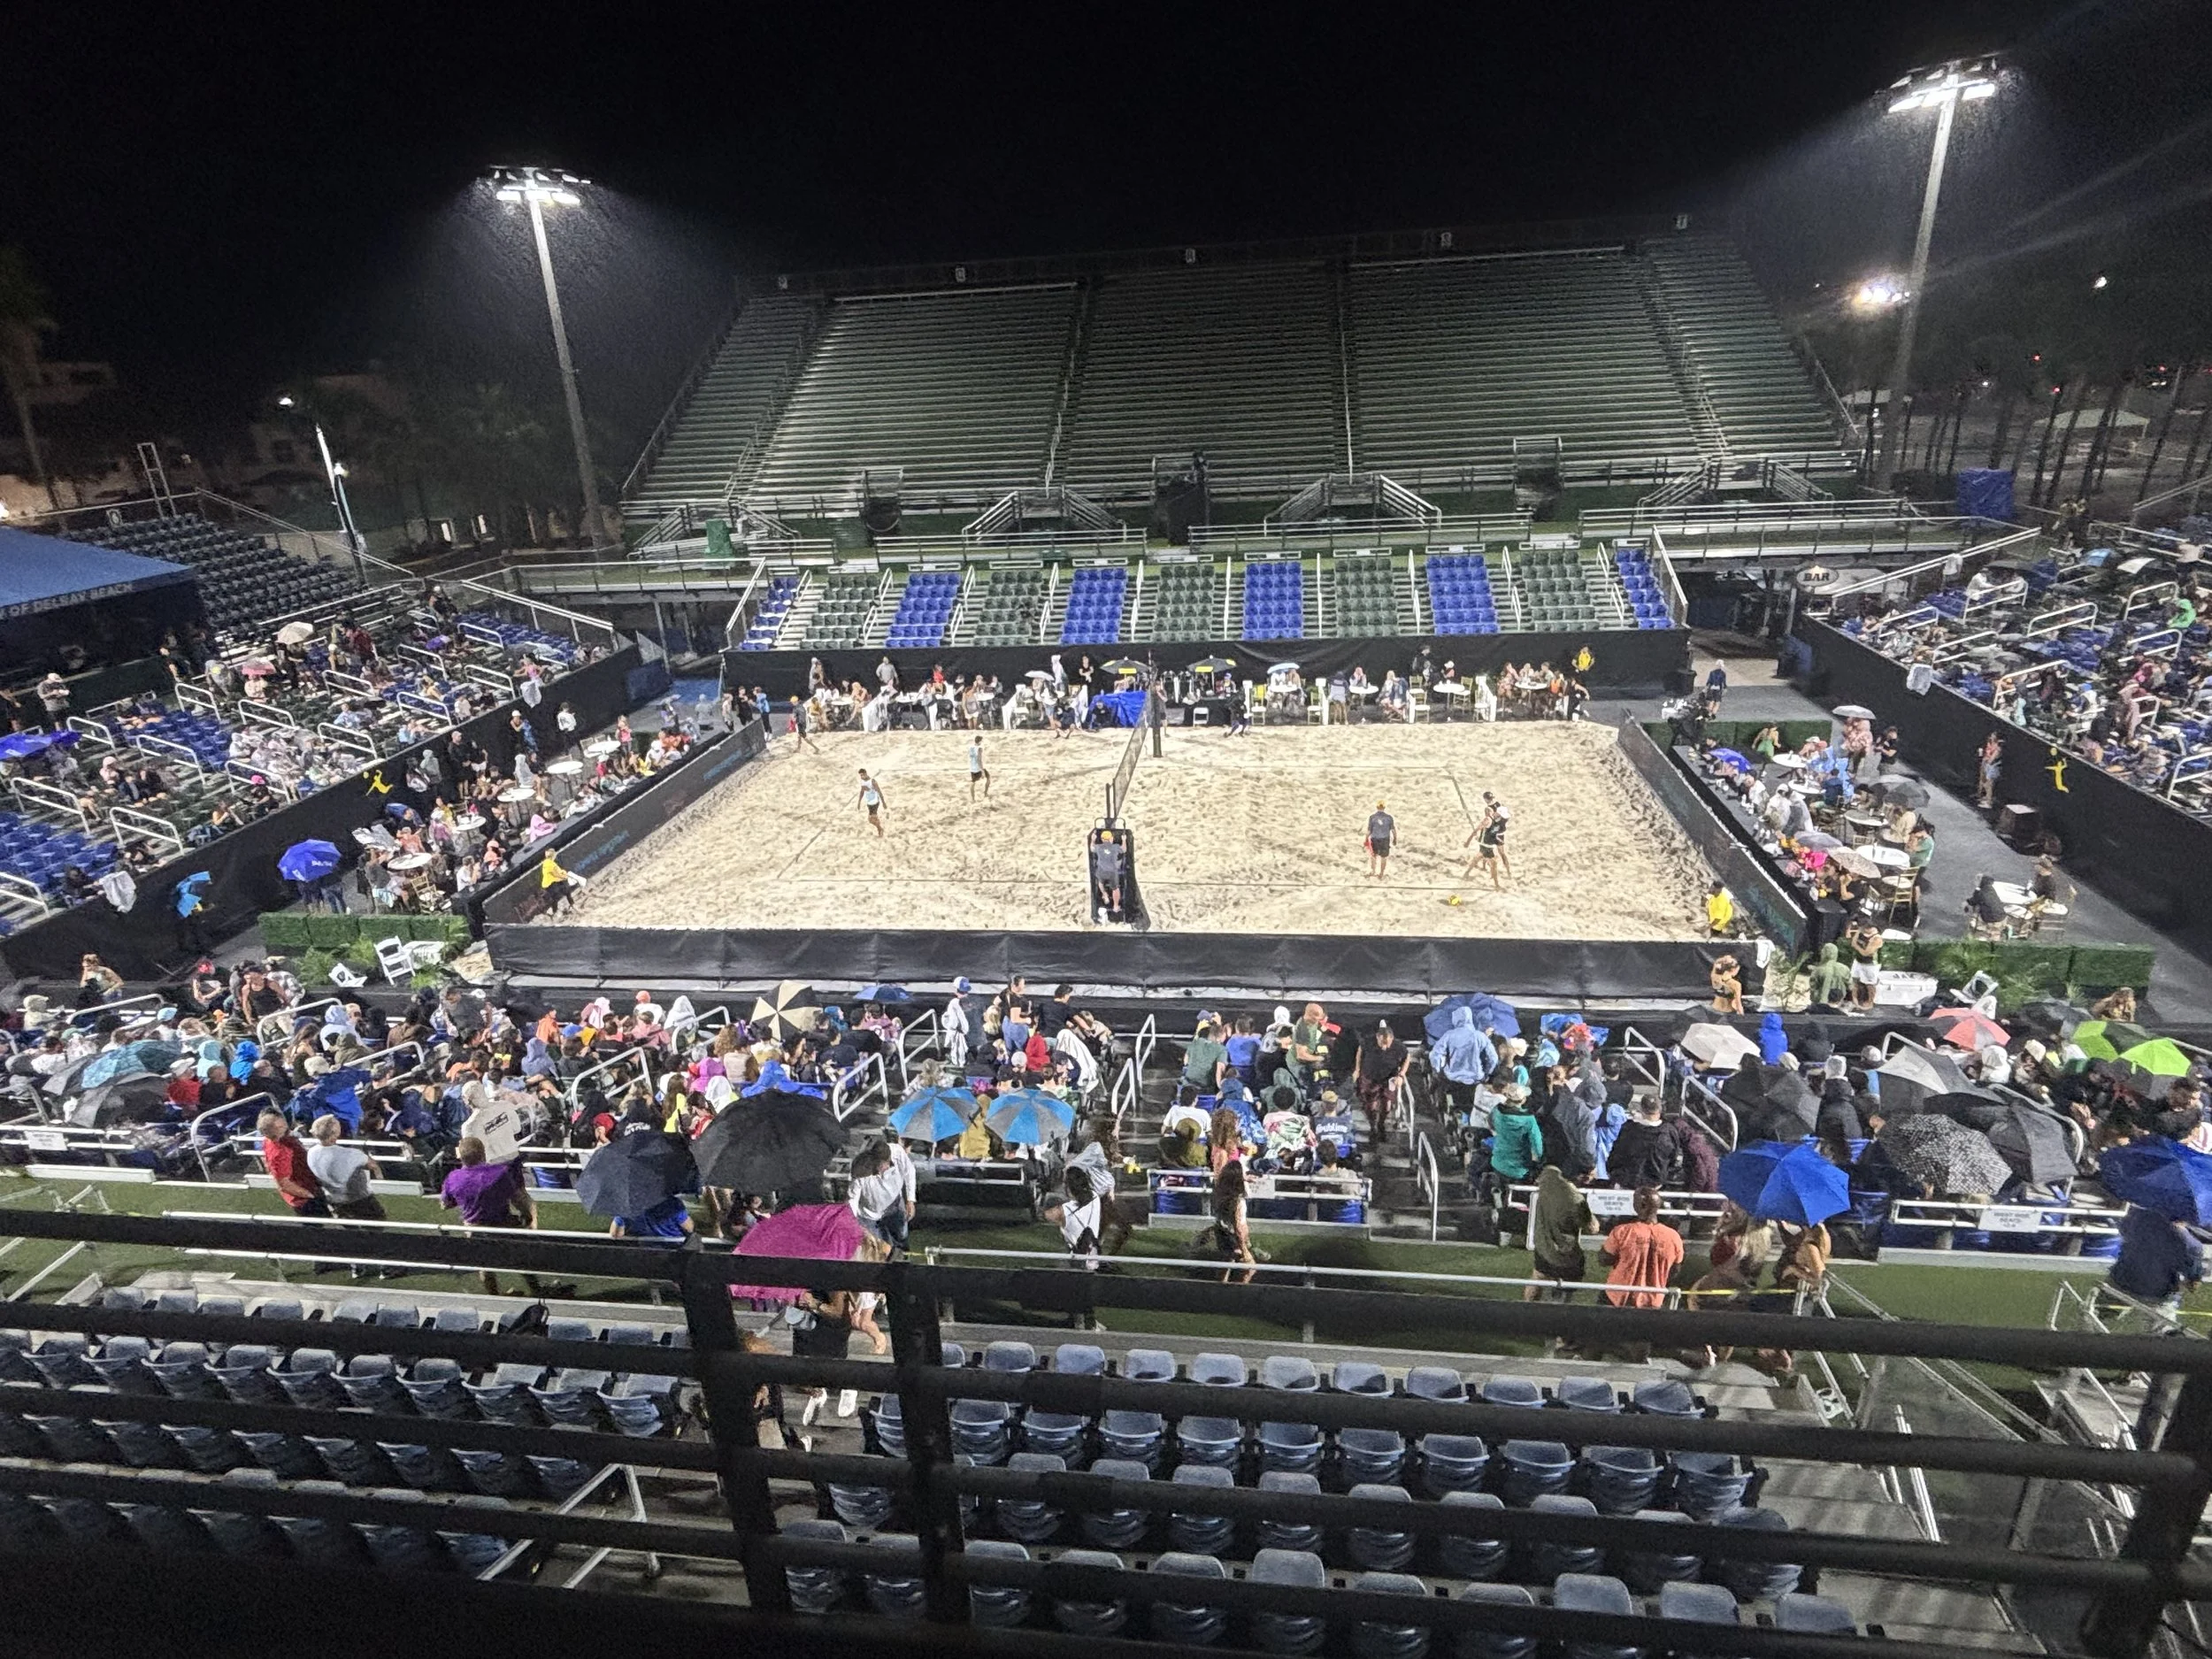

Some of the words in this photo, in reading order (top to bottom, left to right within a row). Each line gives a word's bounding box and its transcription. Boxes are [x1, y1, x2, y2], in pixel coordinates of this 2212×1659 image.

[1804, 572, 1830, 581] BAR
[9, 603, 29, 617] OF
[90, 583, 133, 600] BEACH
